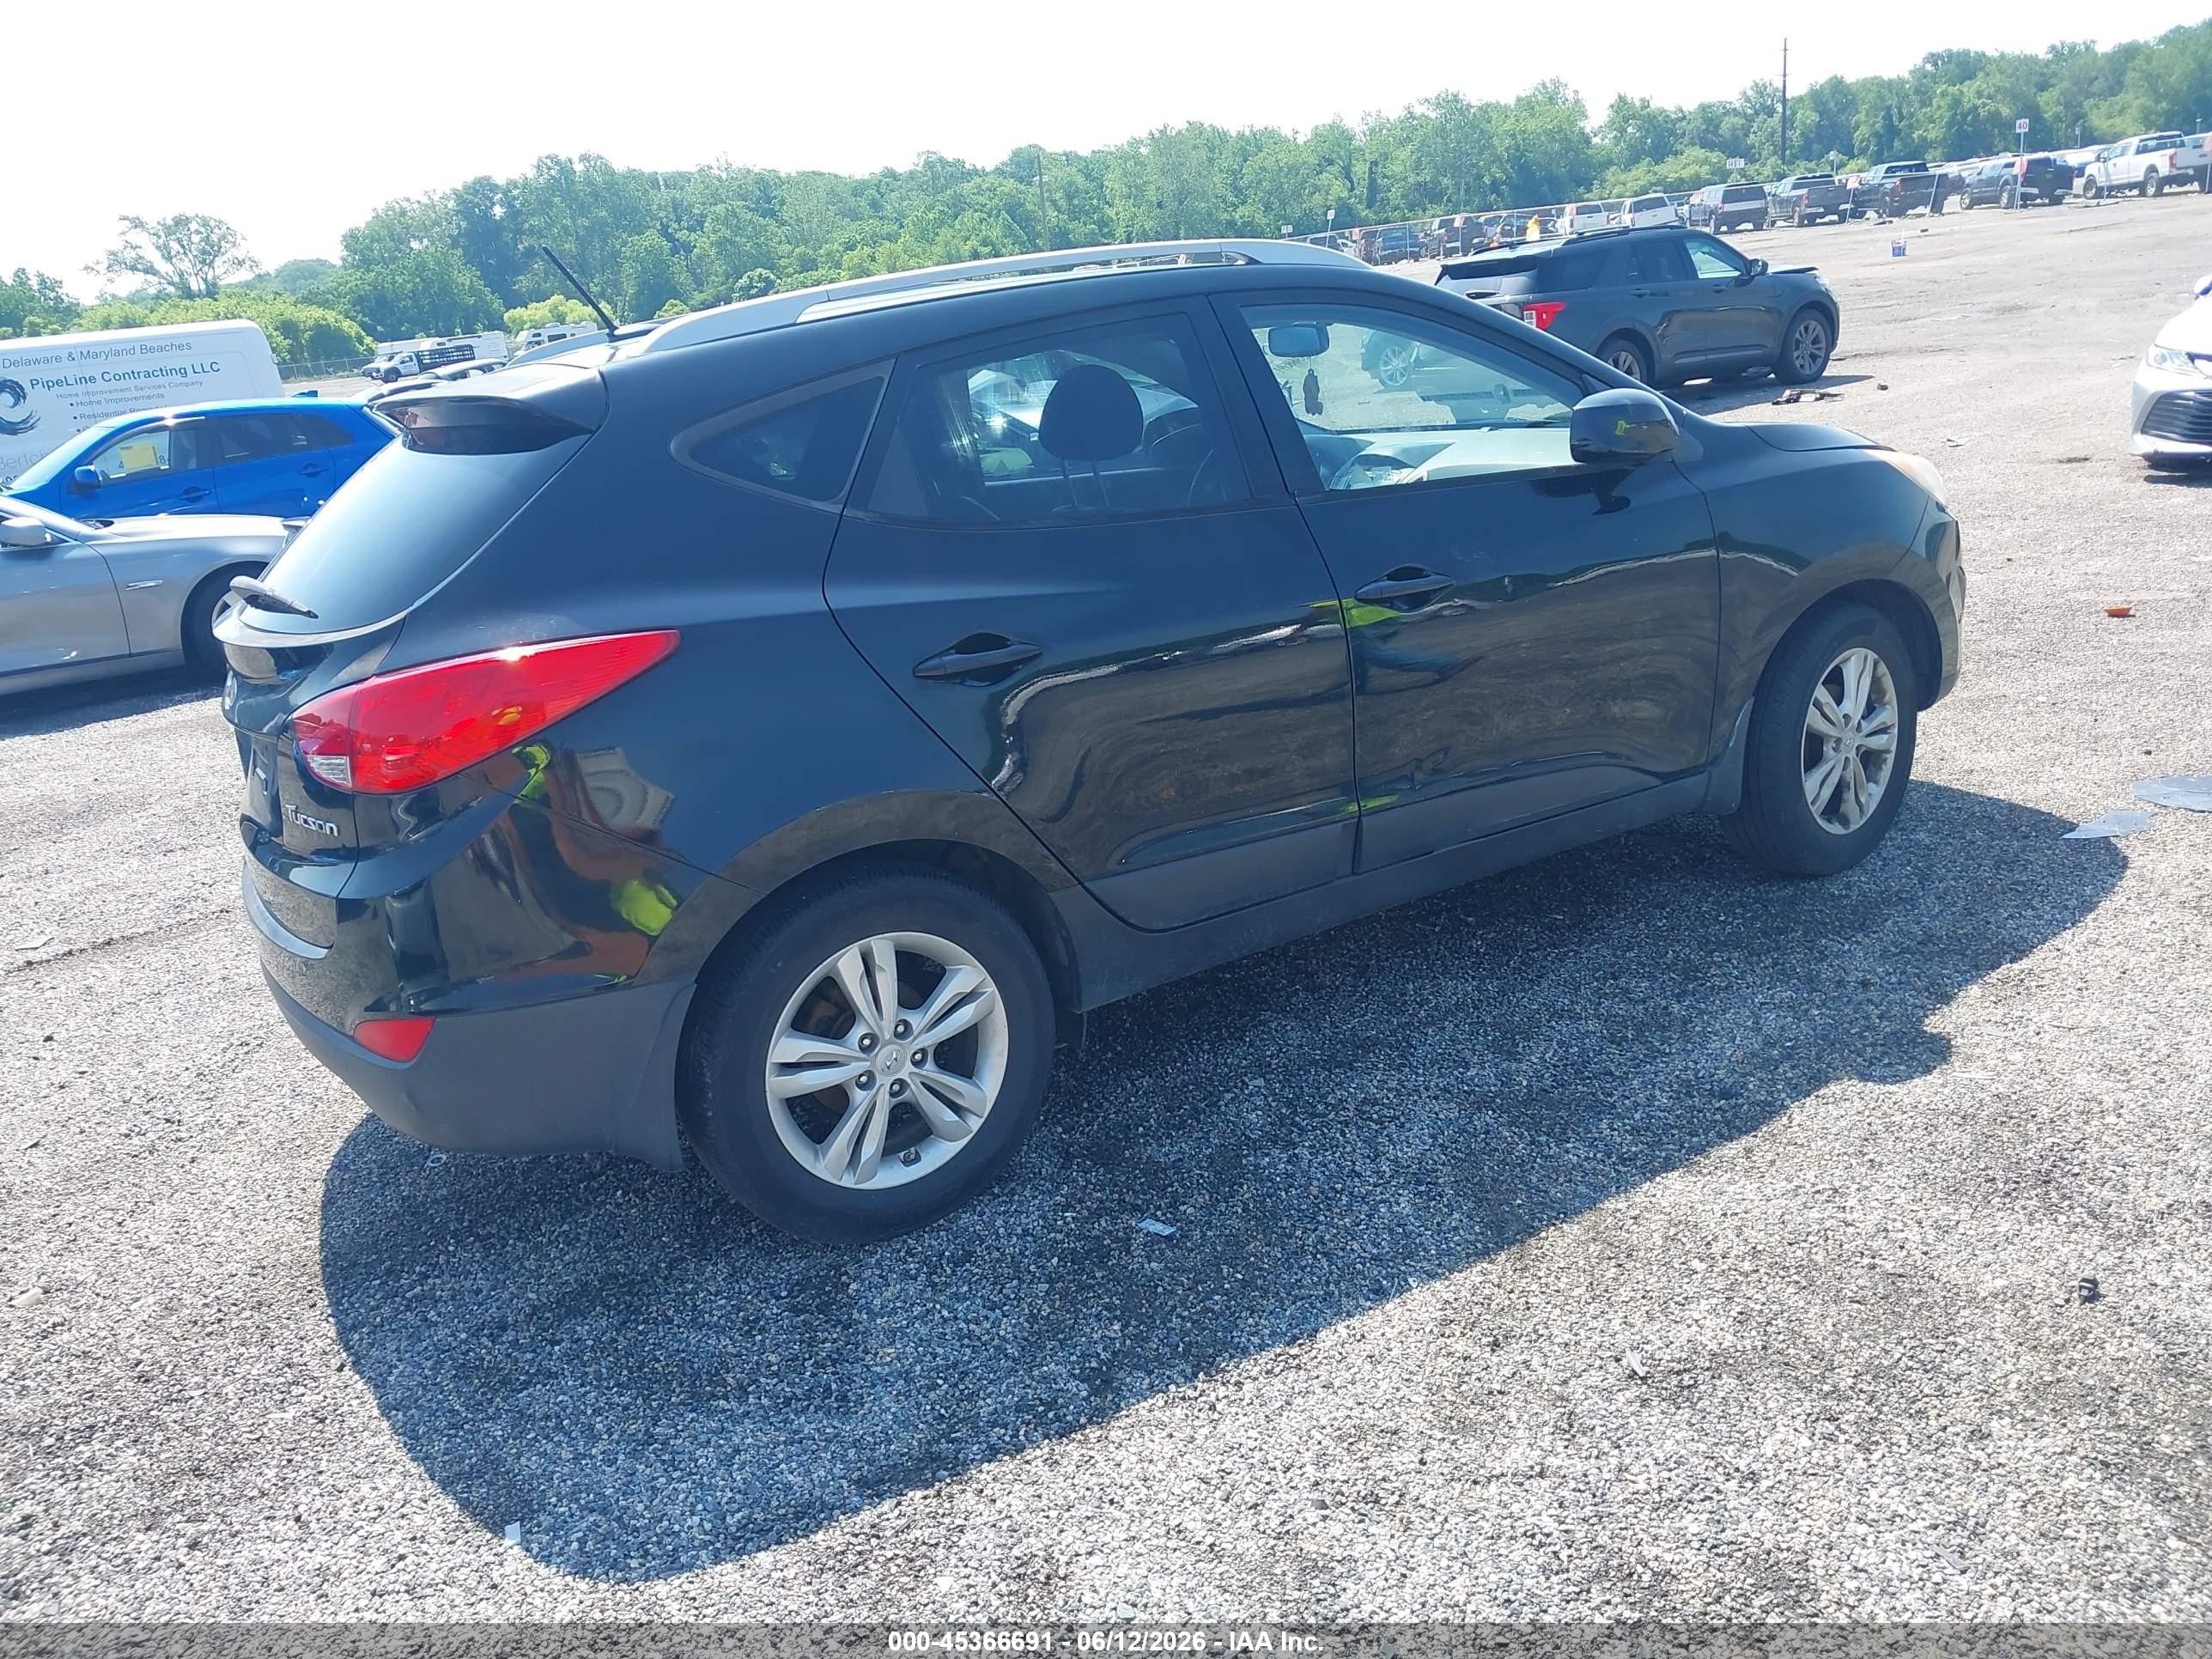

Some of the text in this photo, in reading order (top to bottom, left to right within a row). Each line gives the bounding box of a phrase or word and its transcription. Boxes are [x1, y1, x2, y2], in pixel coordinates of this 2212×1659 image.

[2, 342, 192, 369] Delaware & Maryland Beaches
[29, 362, 221, 392] PipeLine Contracting LLC
[82, 386, 132, 398] Improvement
[134, 383, 167, 392] Services
[168, 380, 204, 389] Company
[76, 392, 166, 408] Home Improvements
[285, 804, 338, 837] Tucson
